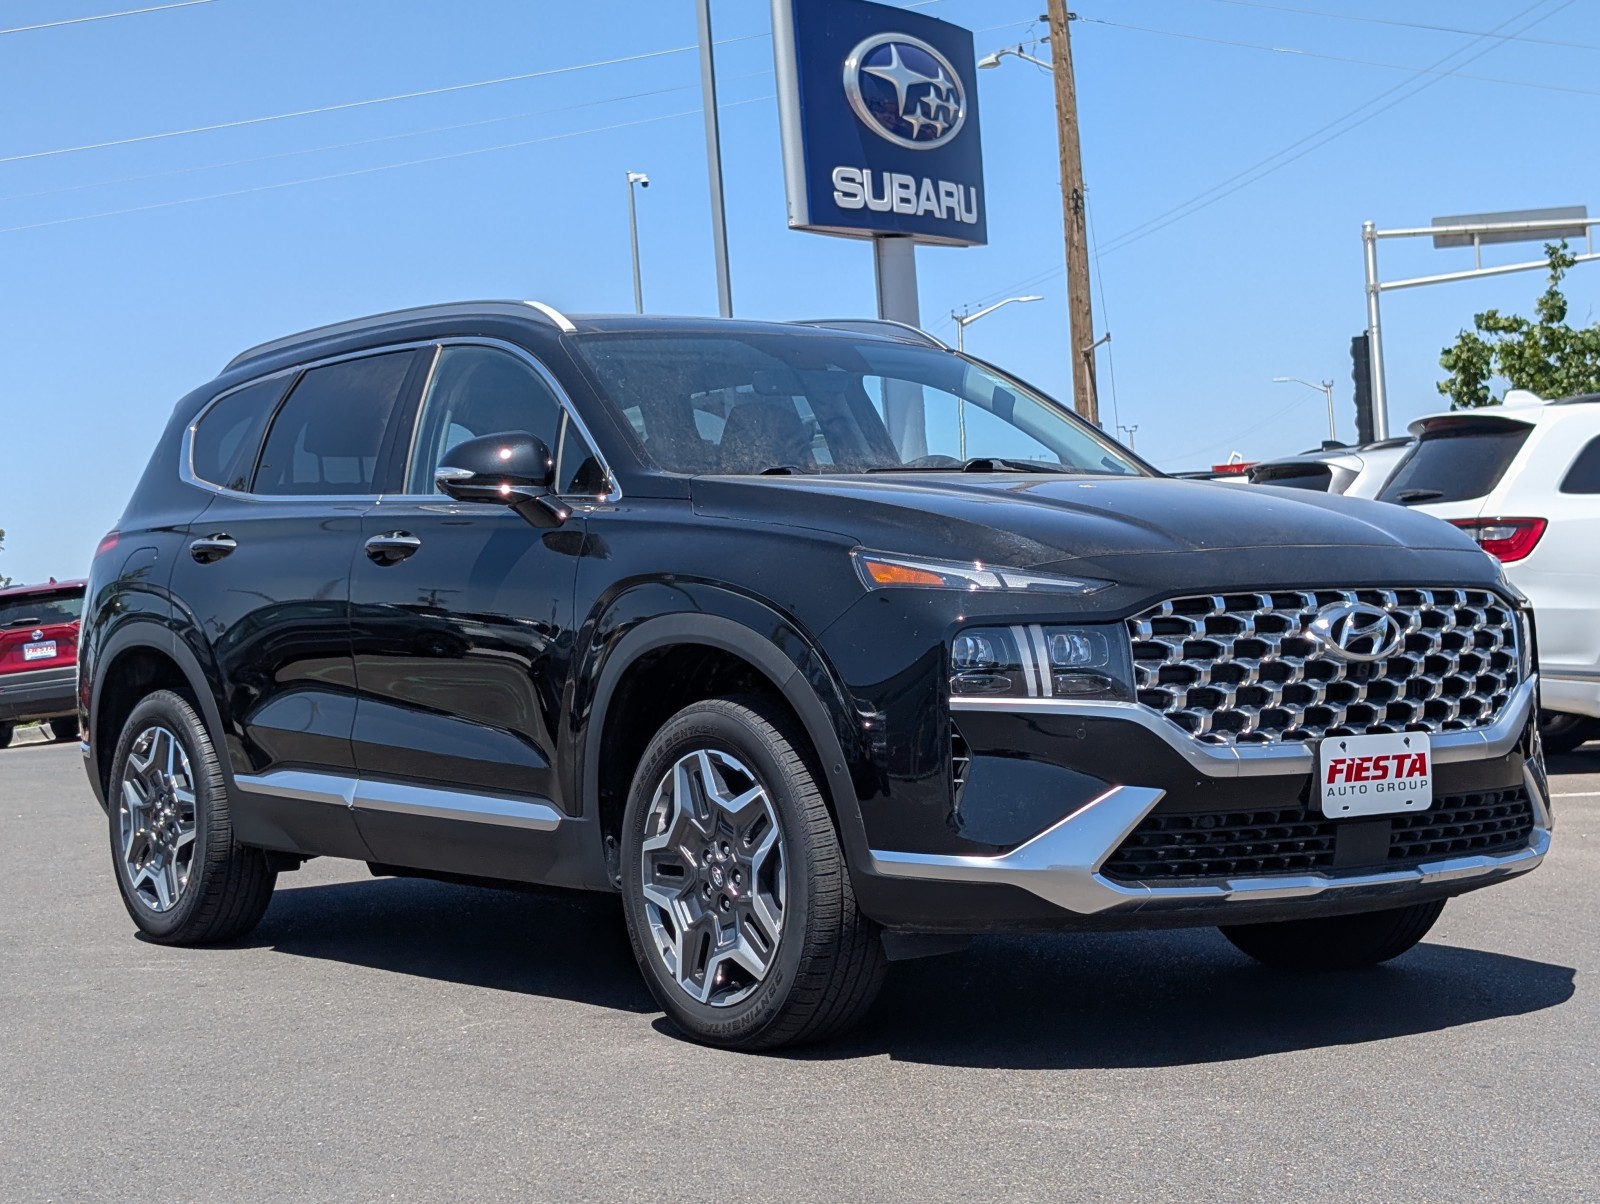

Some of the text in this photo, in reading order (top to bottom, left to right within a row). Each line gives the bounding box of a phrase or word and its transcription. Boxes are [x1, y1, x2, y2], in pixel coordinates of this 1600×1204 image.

[832, 166, 978, 224] SUBARU
[1327, 753, 1427, 784] FIESTA
[1327, 780, 1428, 797] AUTO GROUP
